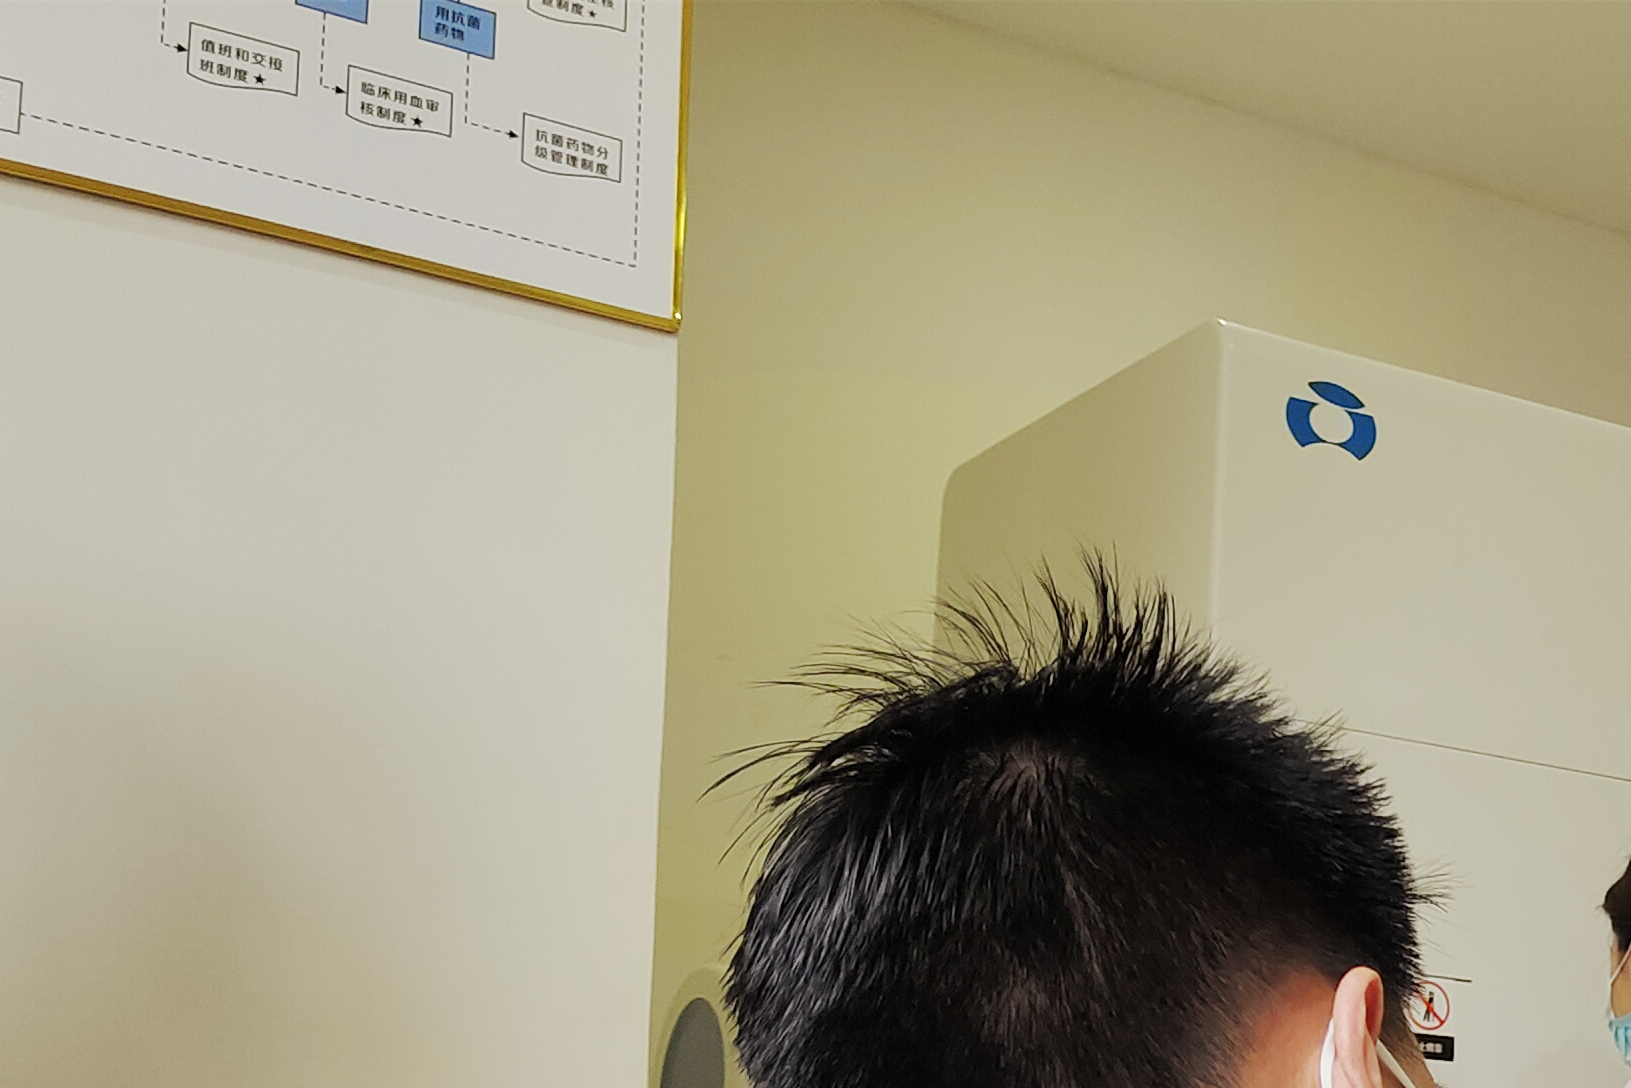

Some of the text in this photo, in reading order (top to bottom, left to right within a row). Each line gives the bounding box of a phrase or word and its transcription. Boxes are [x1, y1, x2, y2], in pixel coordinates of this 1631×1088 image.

[435, 6, 480, 31] 用抗菌
[435, 22, 464, 41] 药物
[201, 39, 283, 72] 值班和交接
[200, 59, 248, 83] 班制度
[361, 82, 439, 112] 临床用血审
[360, 101, 407, 126] 核制度
[535, 129, 609, 160] 抗菌药物分
[535, 145, 609, 176] 级管理制度
